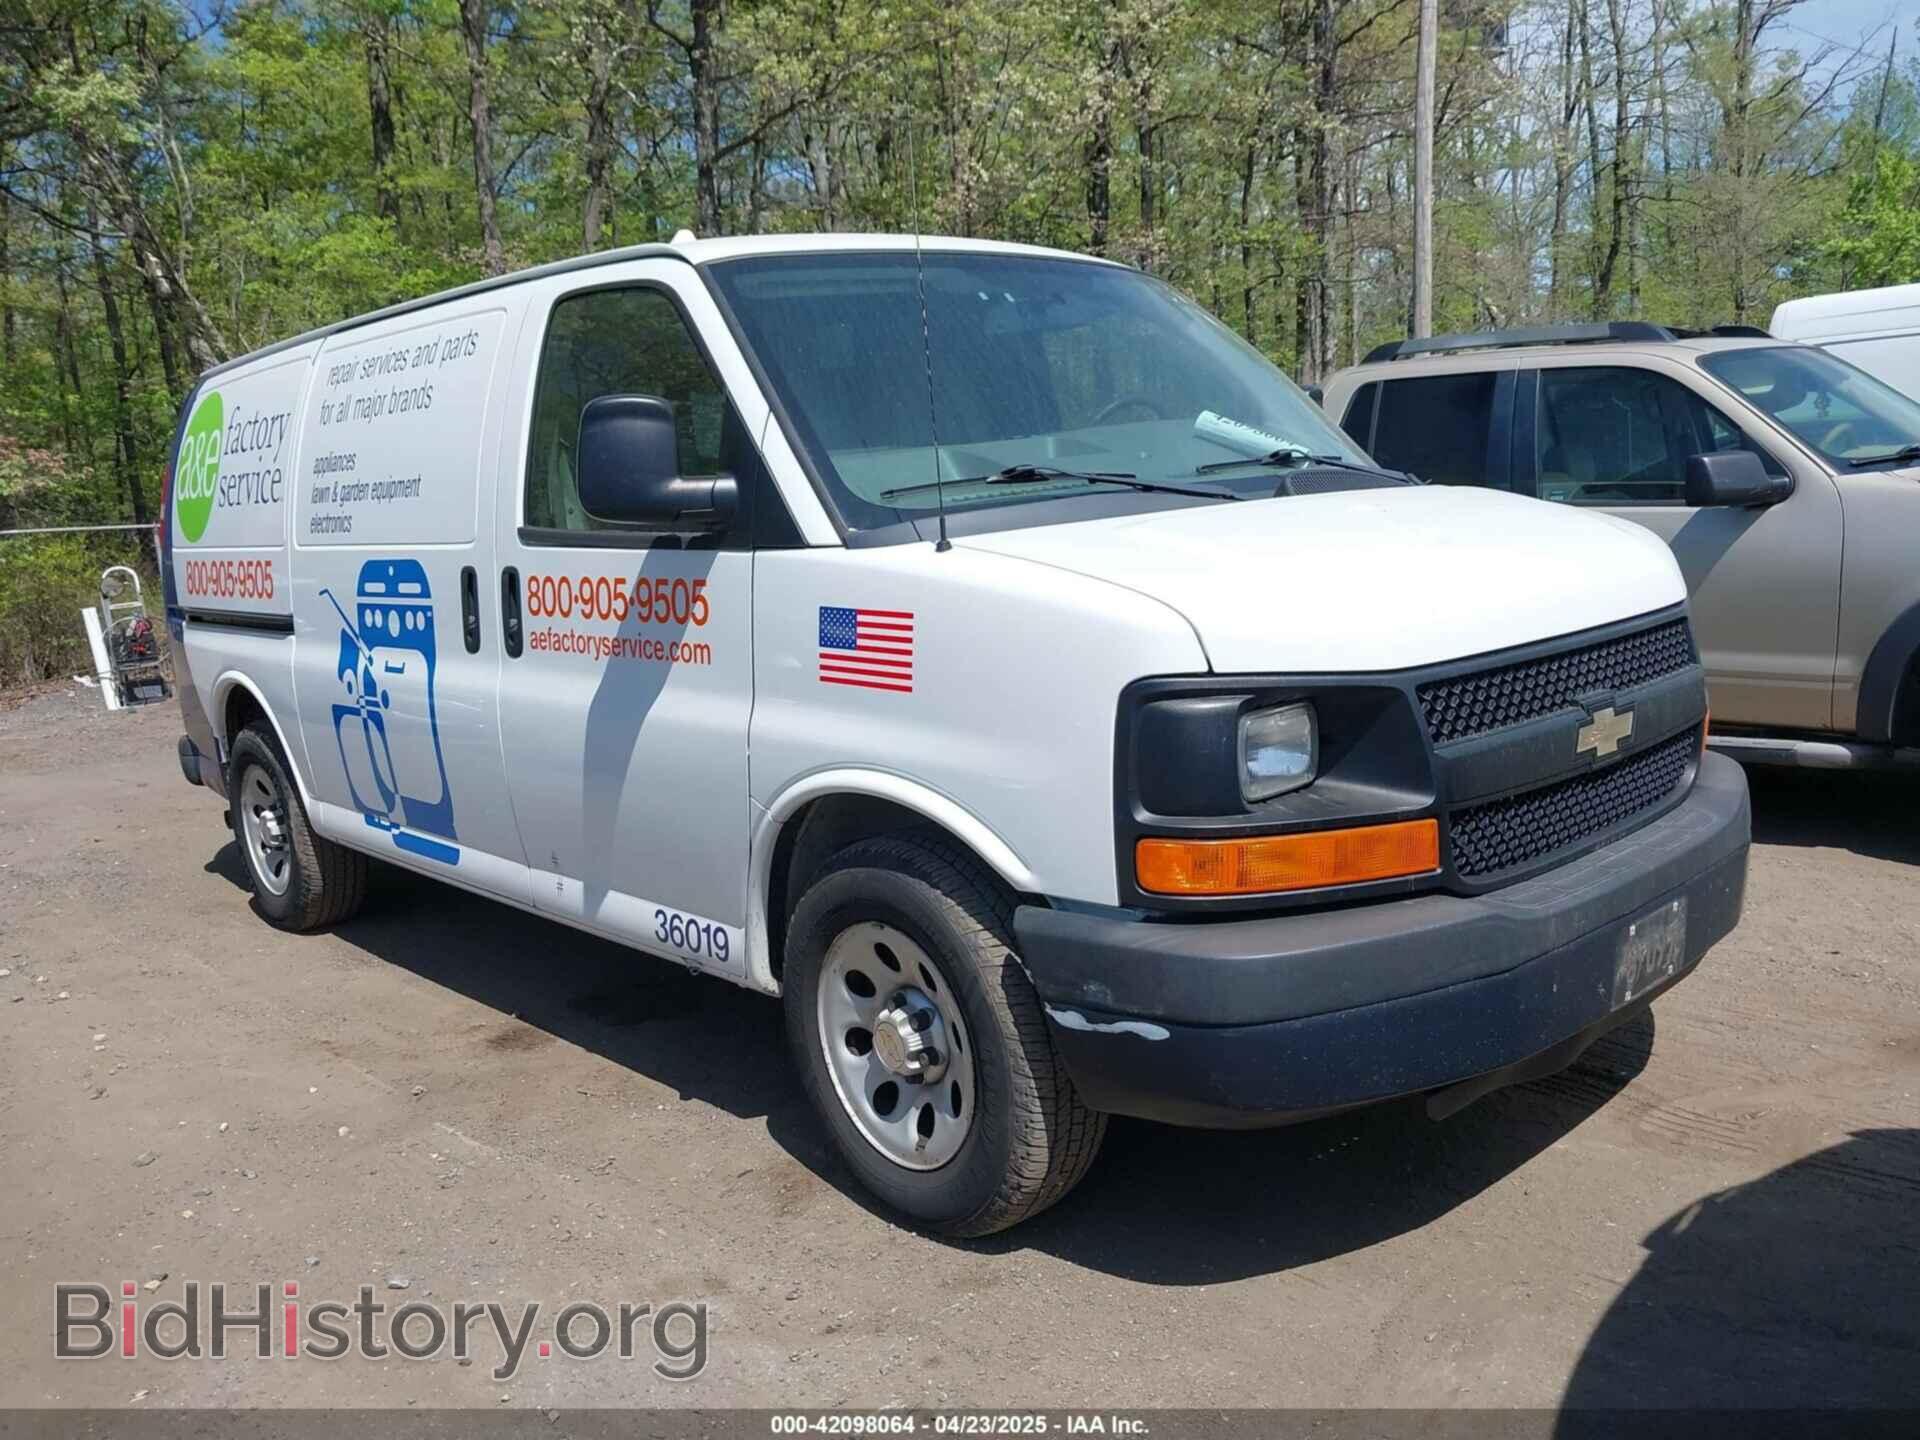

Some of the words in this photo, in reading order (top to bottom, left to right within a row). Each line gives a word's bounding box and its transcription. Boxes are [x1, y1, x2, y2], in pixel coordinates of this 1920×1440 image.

[326, 355, 359, 391] repair
[360, 347, 410, 380] services
[411, 334, 441, 369] and
[439, 328, 479, 369] parts
[319, 399, 335, 428] for
[336, 394, 352, 423] all
[353, 389, 388, 424] major
[388, 378, 434, 415] brands
[224, 405, 291, 463] factory
[178, 429, 220, 501] a&e
[219, 455, 282, 508] service
[311, 482, 330, 504] lawn
[331, 481, 339, 502] &
[339, 479, 370, 507] garden
[371, 473, 422, 504] equipment
[313, 451, 357, 479] appliances
[310, 512, 352, 534] electronics
[529, 625, 711, 666] aefactoryservice.com
[654, 909, 729, 963] 36019
